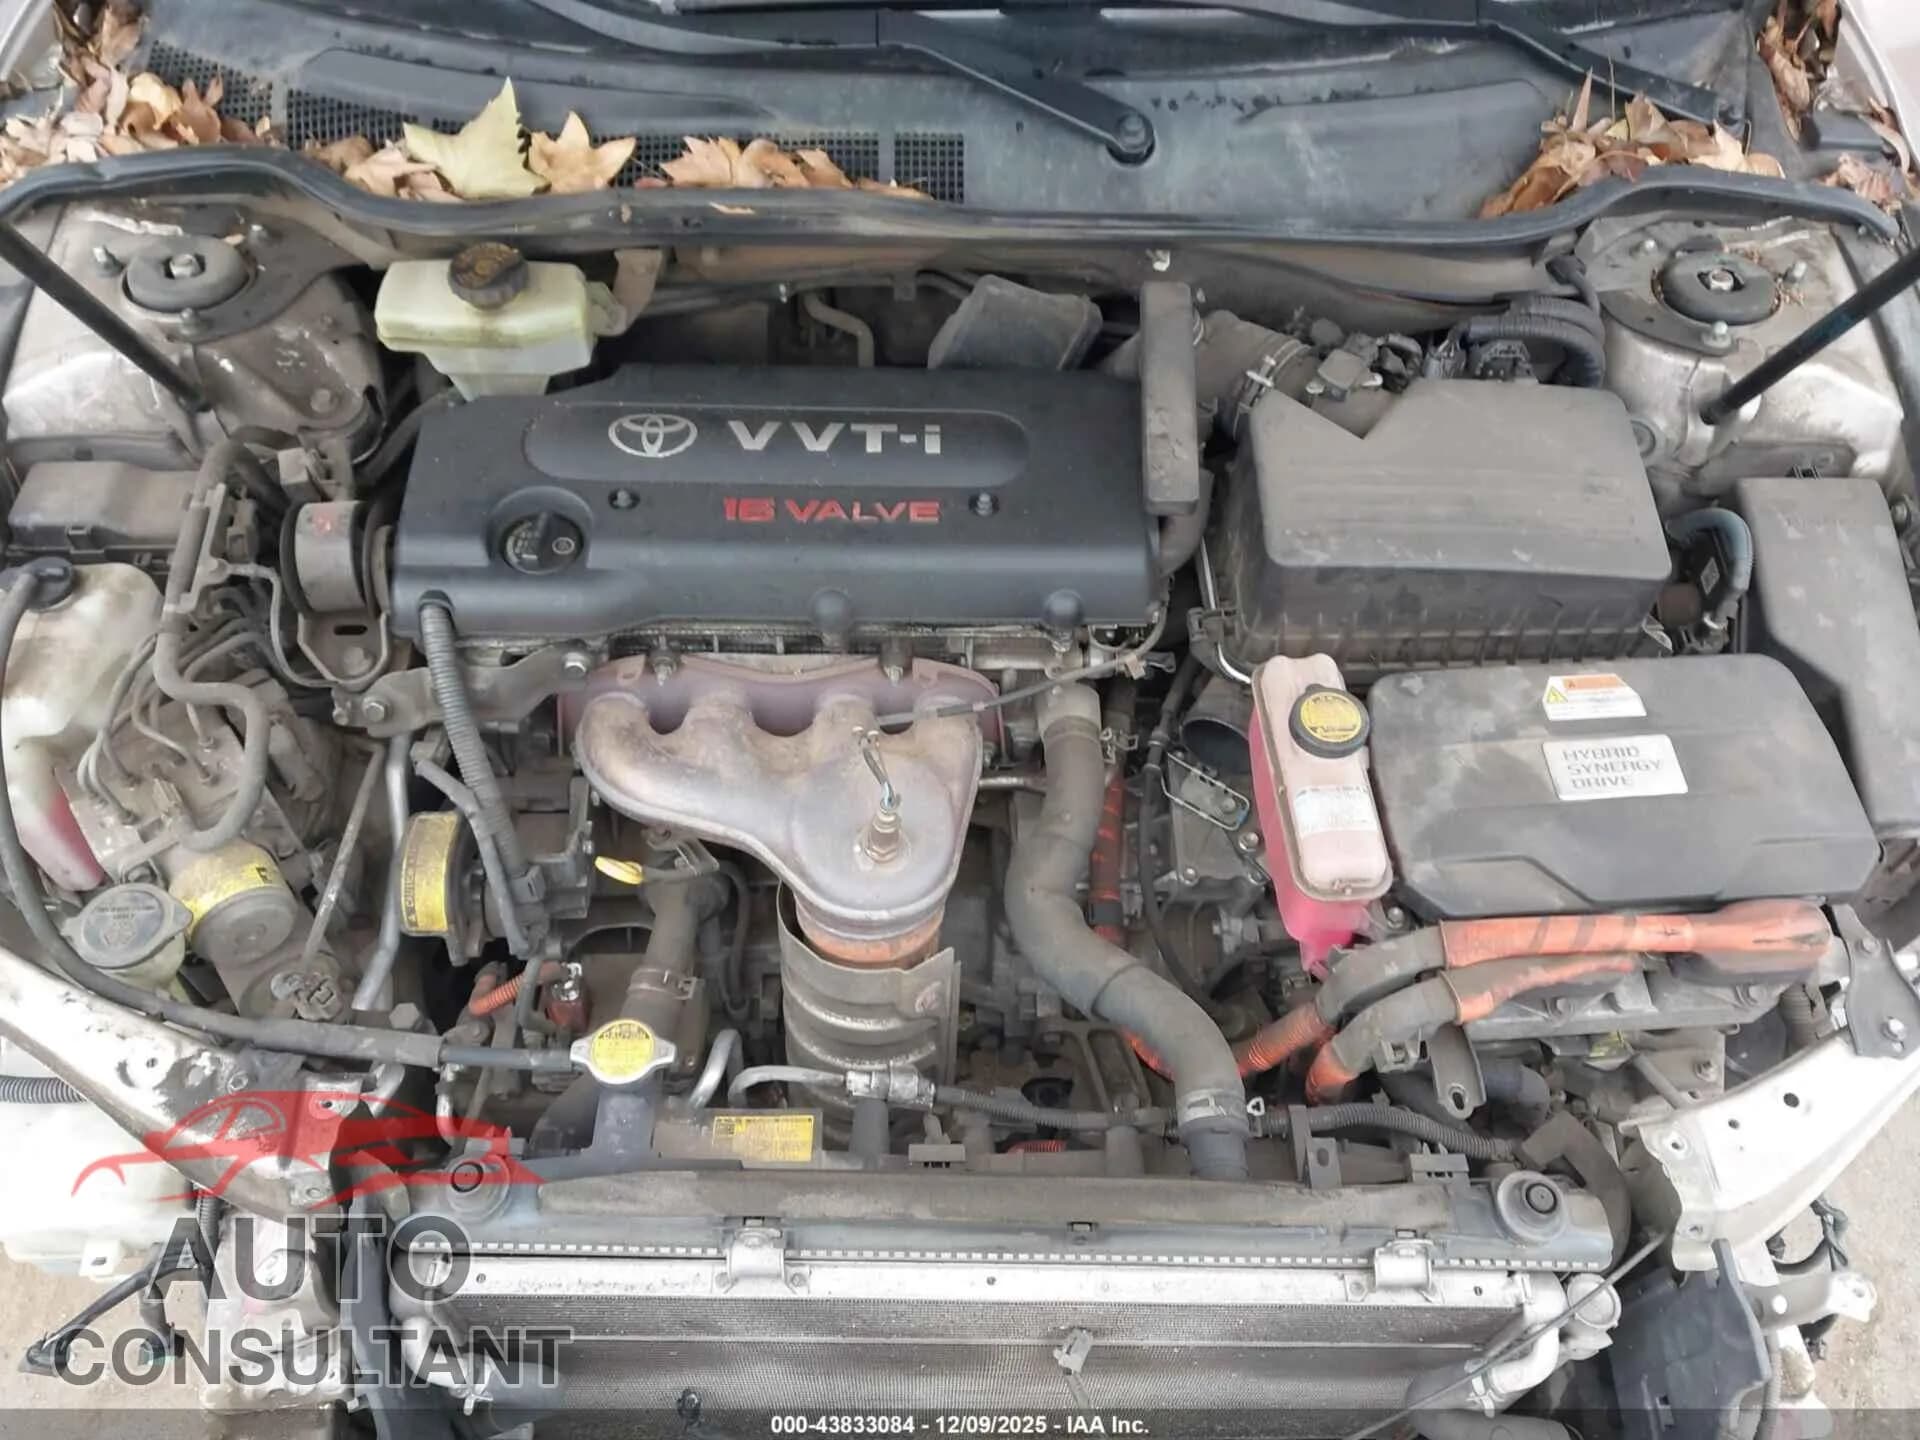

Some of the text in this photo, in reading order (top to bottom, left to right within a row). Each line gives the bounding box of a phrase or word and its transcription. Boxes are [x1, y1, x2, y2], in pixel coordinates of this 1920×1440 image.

[727, 420, 941, 454] VVT-i
[723, 496, 941, 524] 16 VALVE
[1561, 745, 1640, 762] HYBRID
[1567, 759, 1663, 775] SYNERGY
[1571, 776, 1633, 789] DRIVE
